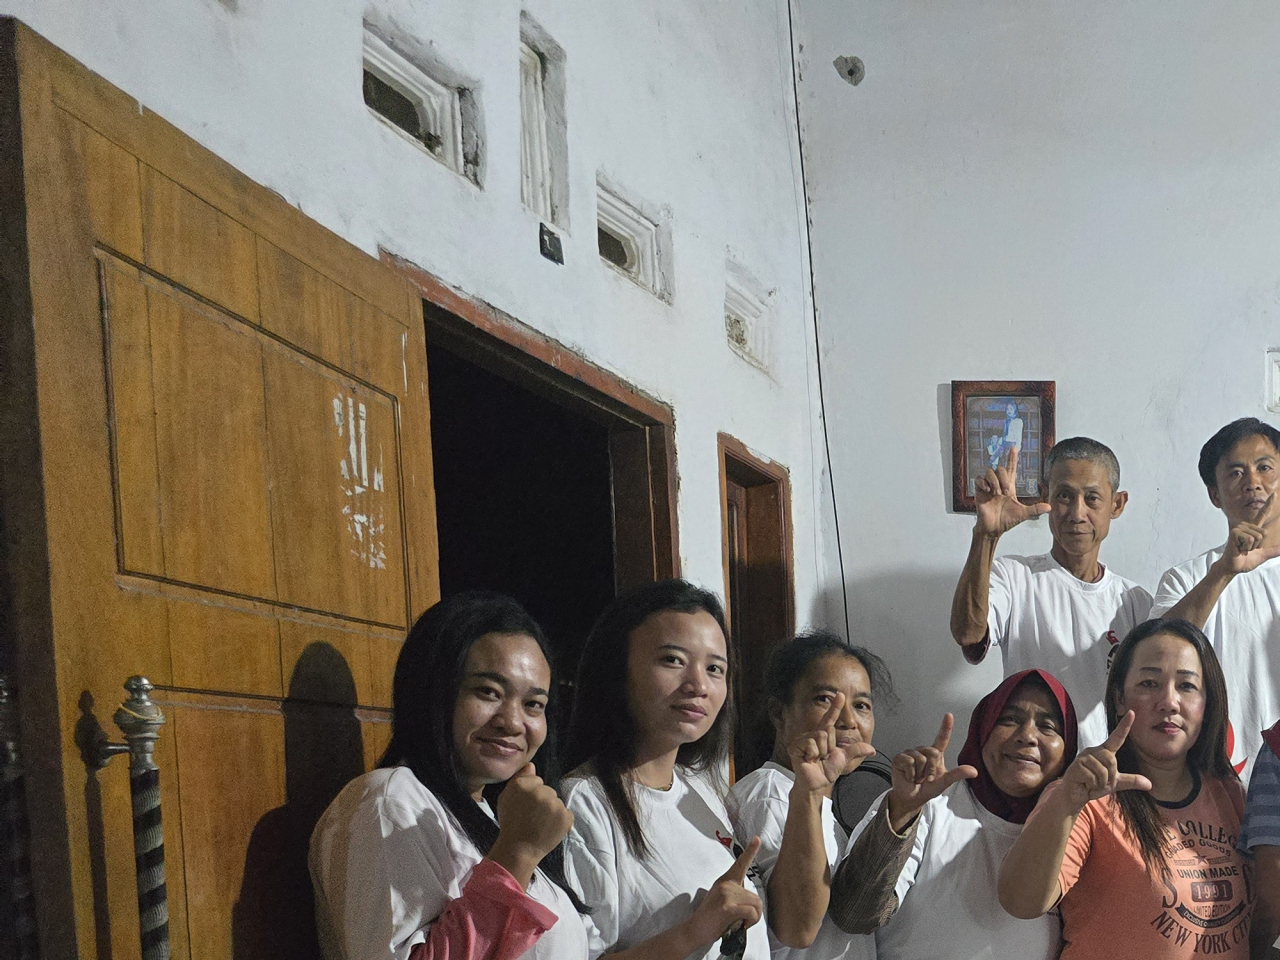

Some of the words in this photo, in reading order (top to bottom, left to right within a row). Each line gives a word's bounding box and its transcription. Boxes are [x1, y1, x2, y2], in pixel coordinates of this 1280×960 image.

[1177, 820, 1238, 849] COLLEG
[1177, 868, 1208, 879] UNION
[1209, 866, 1240, 879] MADE
[1196, 884, 1229, 900] 1991
[1150, 911, 1193, 947] NEW
[1193, 930, 1231, 955] YORK
